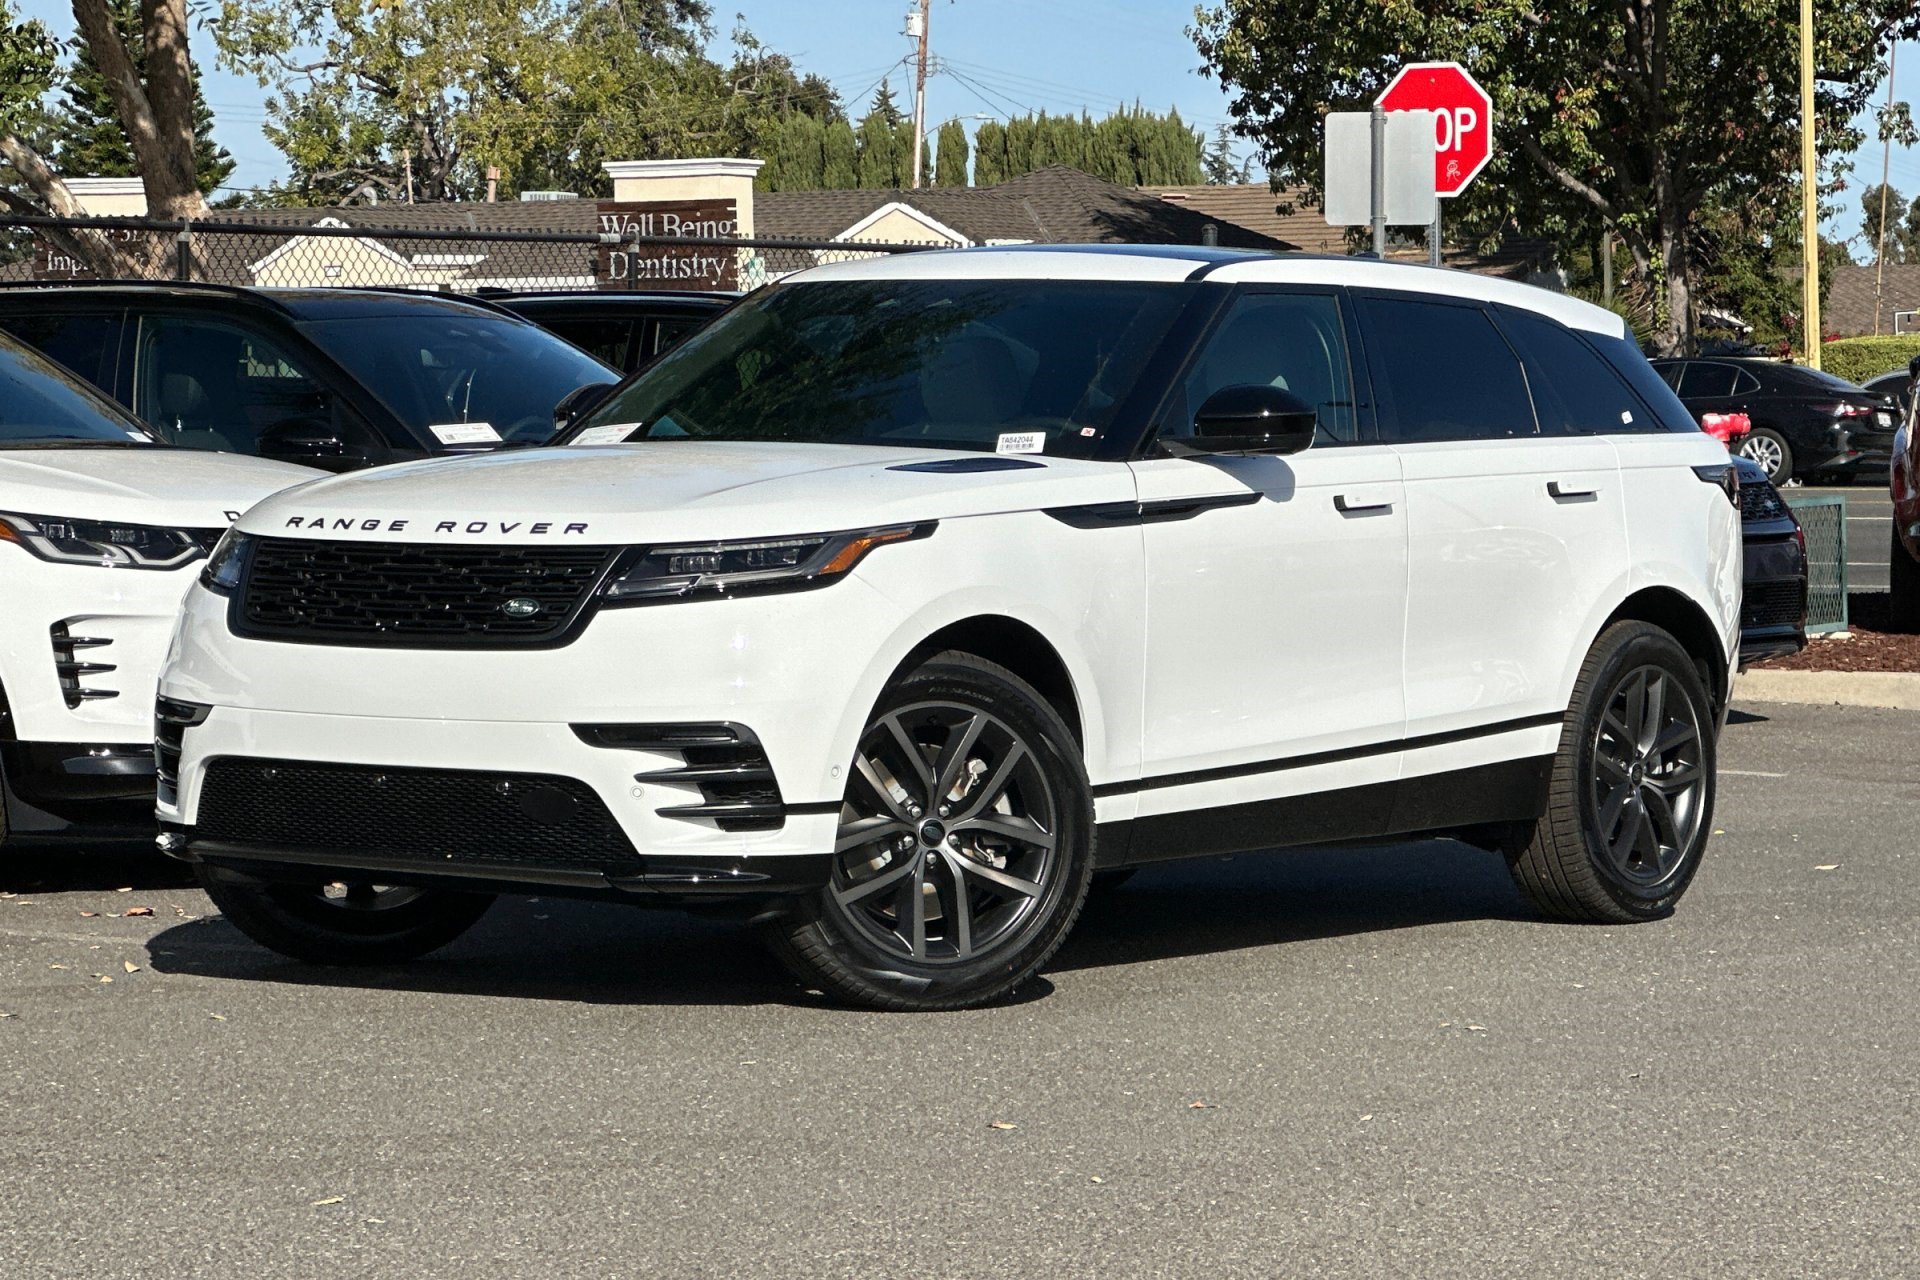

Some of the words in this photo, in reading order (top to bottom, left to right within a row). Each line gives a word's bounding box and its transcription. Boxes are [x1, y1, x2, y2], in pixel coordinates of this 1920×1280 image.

[600, 213, 653, 237] Well
[661, 212, 733, 238] Being
[608, 250, 727, 285] Dentistry
[285, 516, 409, 532] RANGE
[435, 521, 588, 535] ROVER
